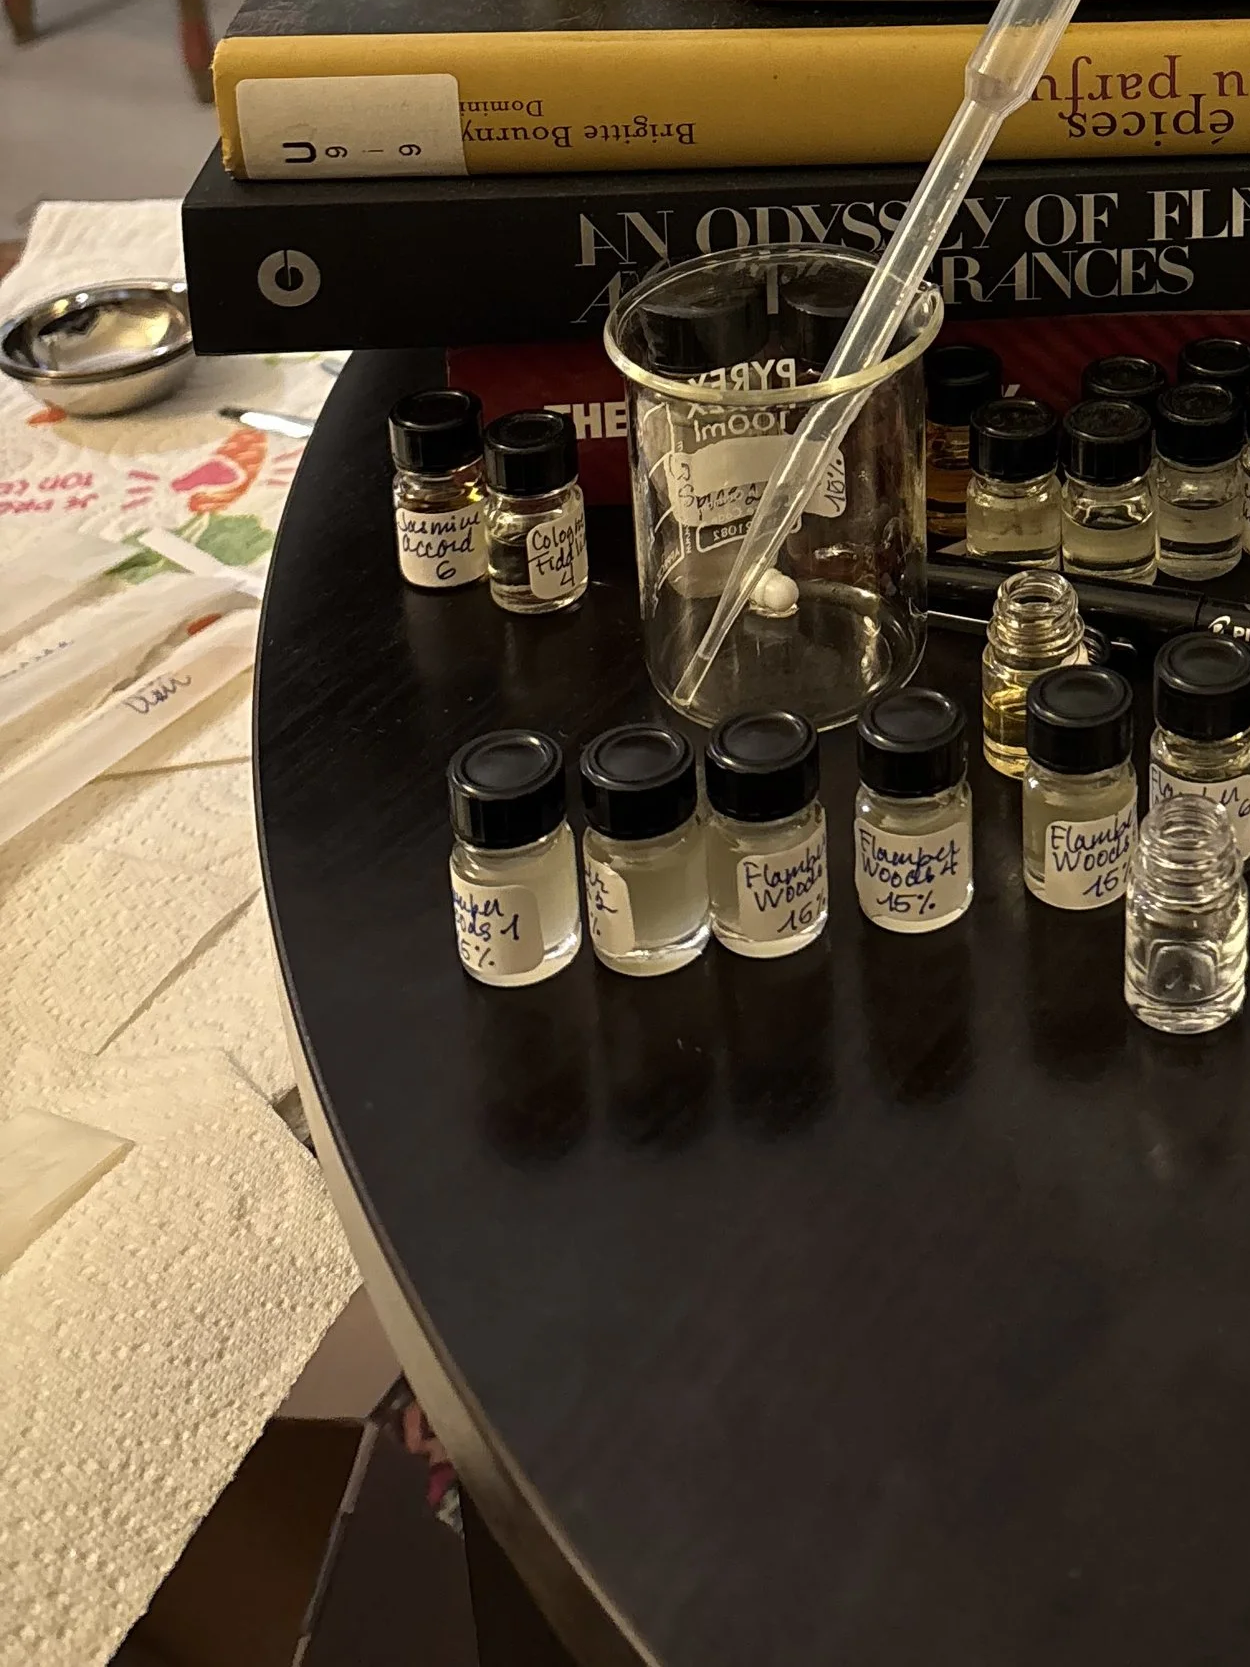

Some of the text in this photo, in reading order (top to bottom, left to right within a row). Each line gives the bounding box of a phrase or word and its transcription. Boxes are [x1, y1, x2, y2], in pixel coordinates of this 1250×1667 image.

[460, 115, 697, 149] Brigitte Bourny
[1068, 93, 1236, 148] épices
[574, 209, 674, 267] AN
[695, 194, 1011, 254] ODYSSY
[1024, 192, 1119, 248] OF
[435, 560, 457, 580] 6
